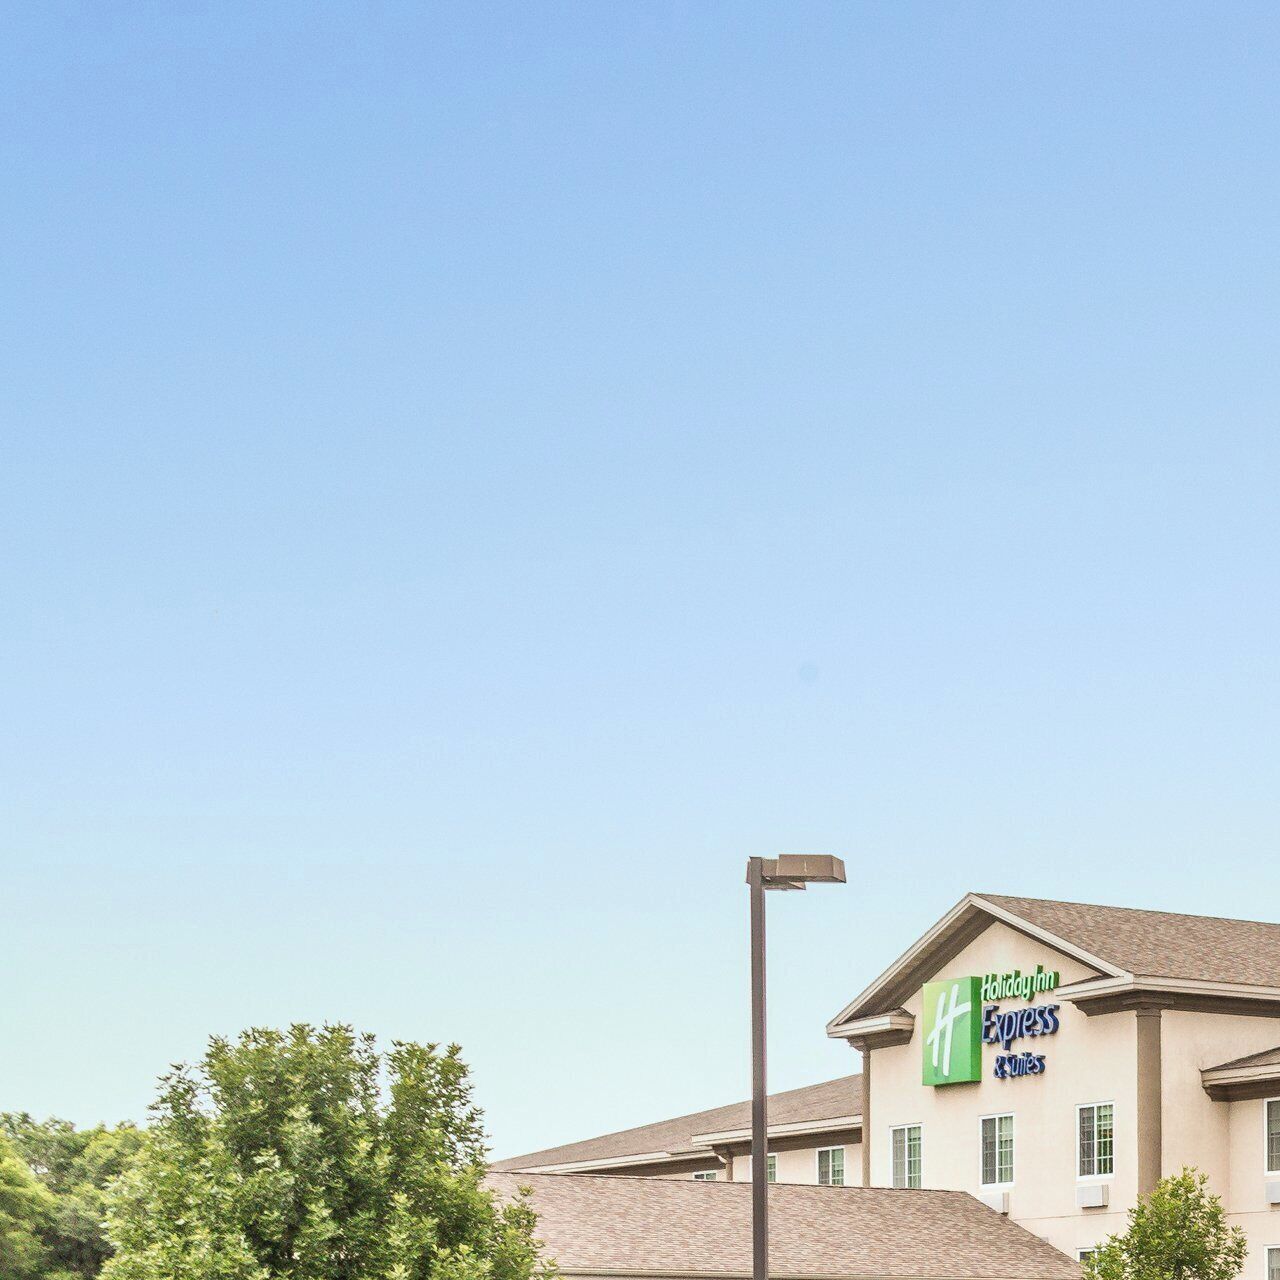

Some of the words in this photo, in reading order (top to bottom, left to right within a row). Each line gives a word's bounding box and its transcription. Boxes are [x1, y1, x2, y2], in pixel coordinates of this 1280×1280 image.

[981, 970, 1034, 1001] Holiday
[1034, 964, 1059, 991] Inn
[982, 1004, 1060, 1050] Express
[993, 1055, 1007, 1079] &
[1004, 1052, 1046, 1078] Suites
